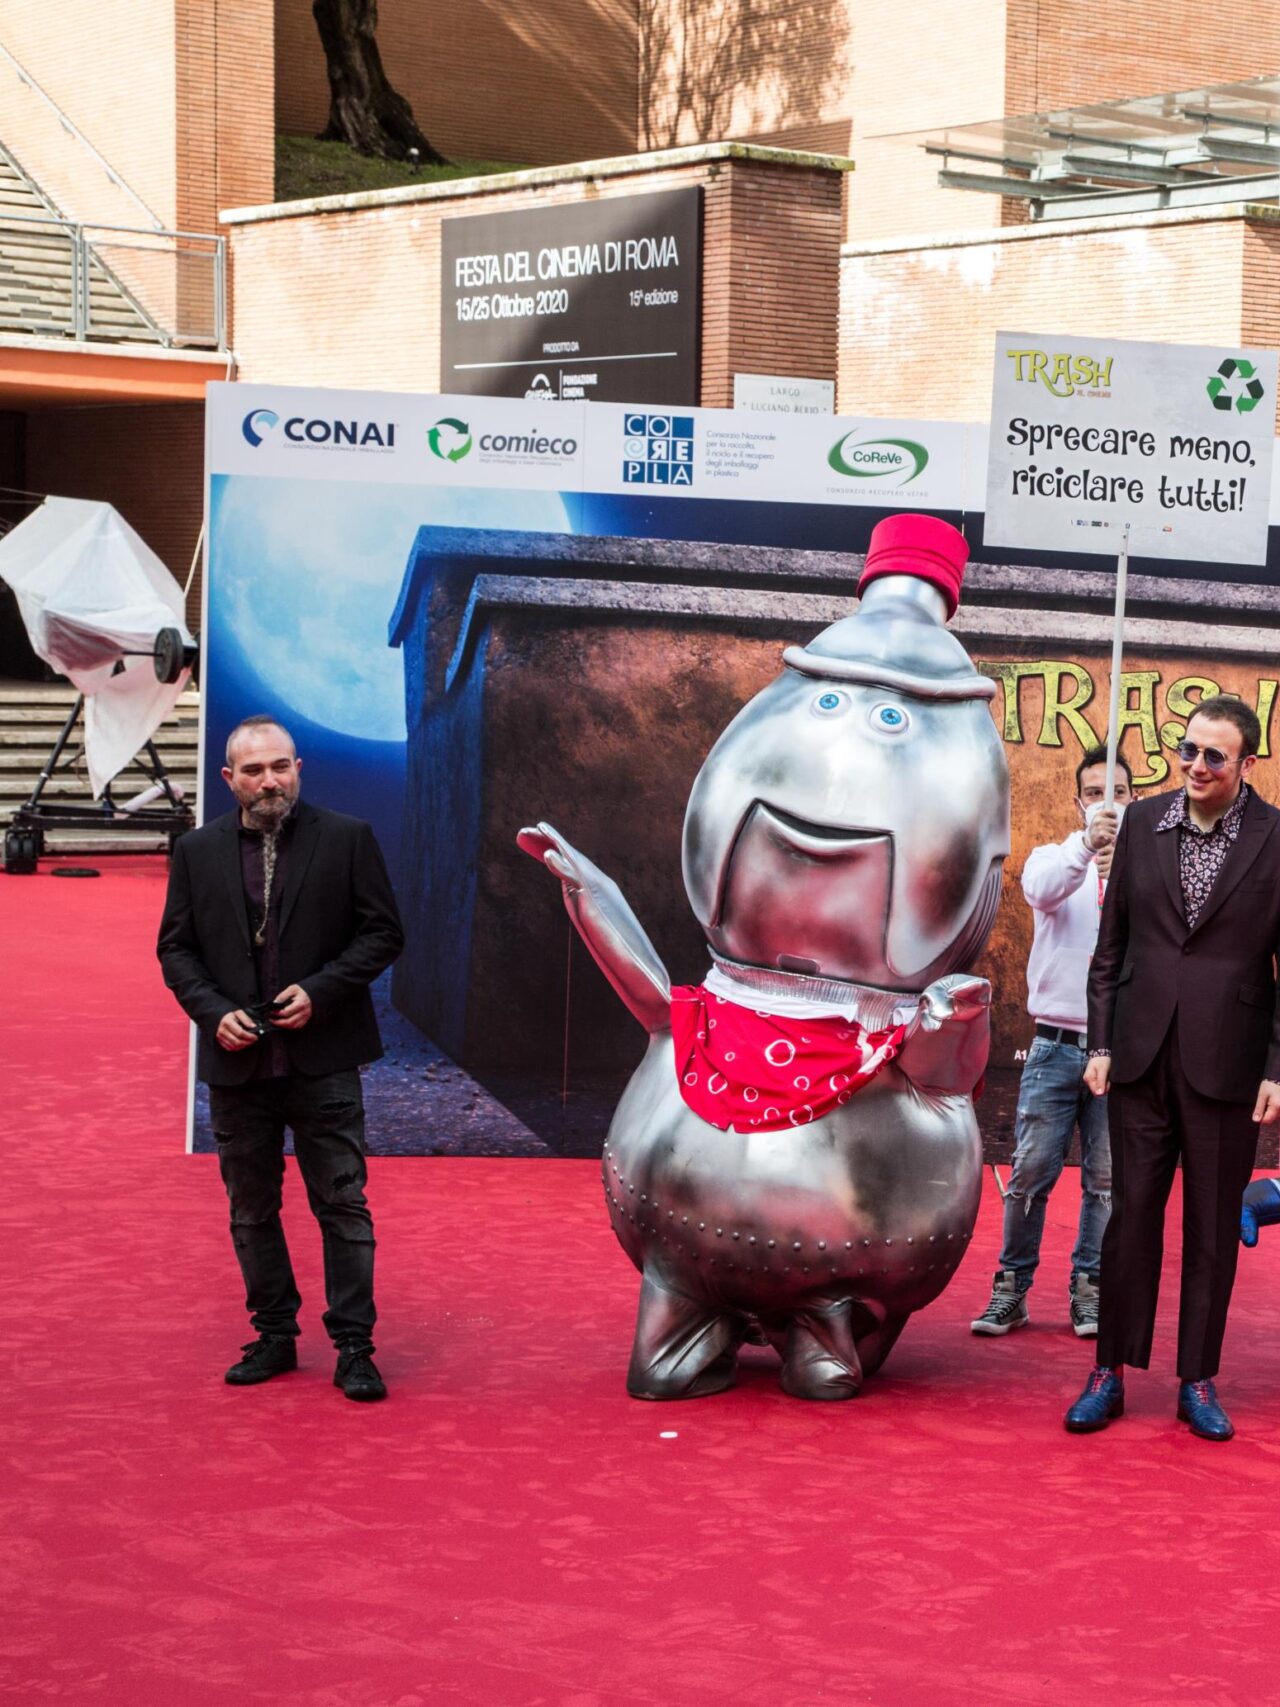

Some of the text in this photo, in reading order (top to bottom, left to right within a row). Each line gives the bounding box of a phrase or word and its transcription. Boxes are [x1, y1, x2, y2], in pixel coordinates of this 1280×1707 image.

[456, 236, 679, 287] FESTA DEL CINEMA DI ROMA
[456, 289, 569, 321] 15/25 Ottobre 2020
[644, 290, 679, 306] edizione
[1007, 349, 1114, 398] TRASH
[770, 387, 801, 397] LARGO
[751, 402, 820, 414] LUCIANO BERIO
[284, 417, 395, 446] CONAI
[479, 428, 577, 455] comieco
[706, 430, 776, 441] Consorzio Nazionale
[1007, 417, 1256, 467] Sprecare meno,
[706, 442, 718, 450] per
[744, 453, 774, 461] recupero
[853, 450, 902, 464] CoReVe
[1012, 464, 1246, 512] riciclare tutti!
